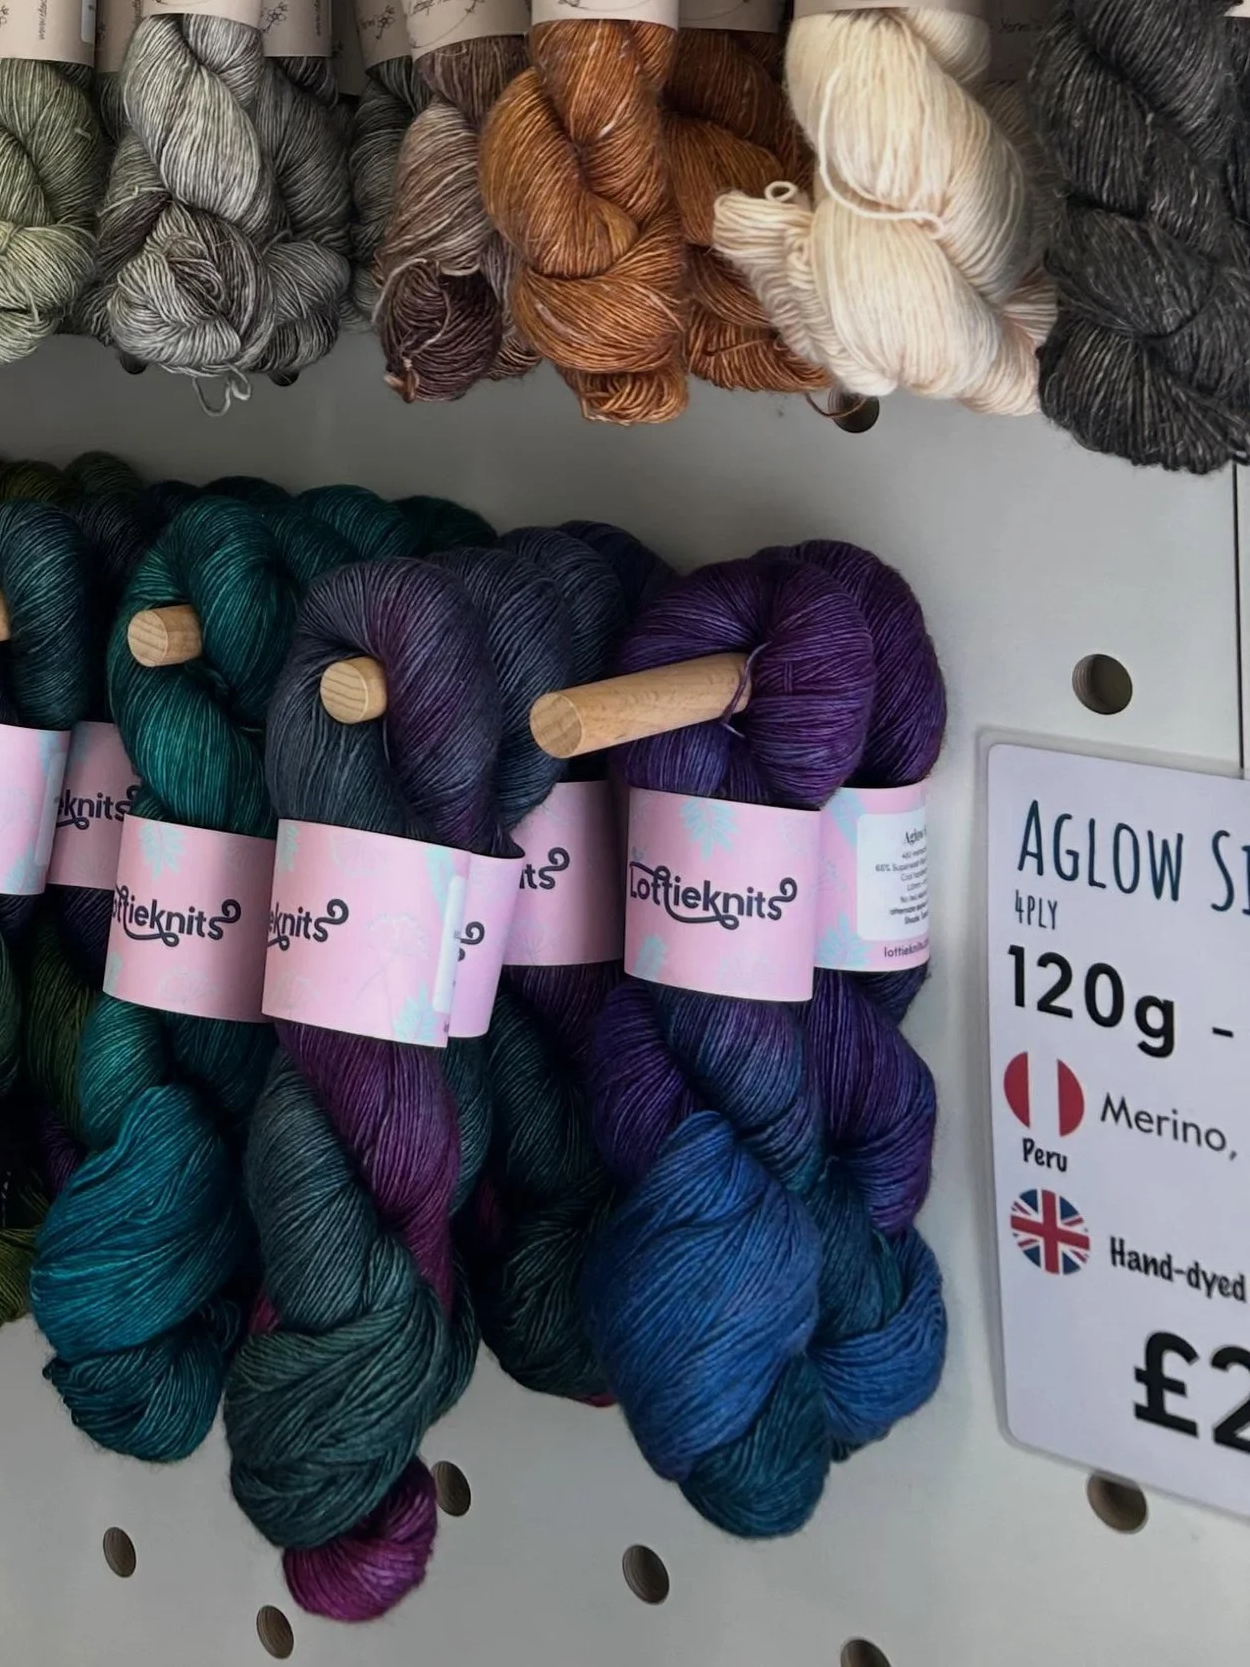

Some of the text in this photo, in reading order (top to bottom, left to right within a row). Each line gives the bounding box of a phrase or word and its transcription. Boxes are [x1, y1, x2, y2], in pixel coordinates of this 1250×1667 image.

[1018, 799, 1184, 903] AGLOW
[1014, 889, 1058, 931] 4PLY
[1007, 943, 1176, 1059] 120g
[1022, 1137, 1068, 1173] Peru
[1100, 1091, 1238, 1162] Merino,
[1109, 1235, 1247, 1303] Hand-dyed
